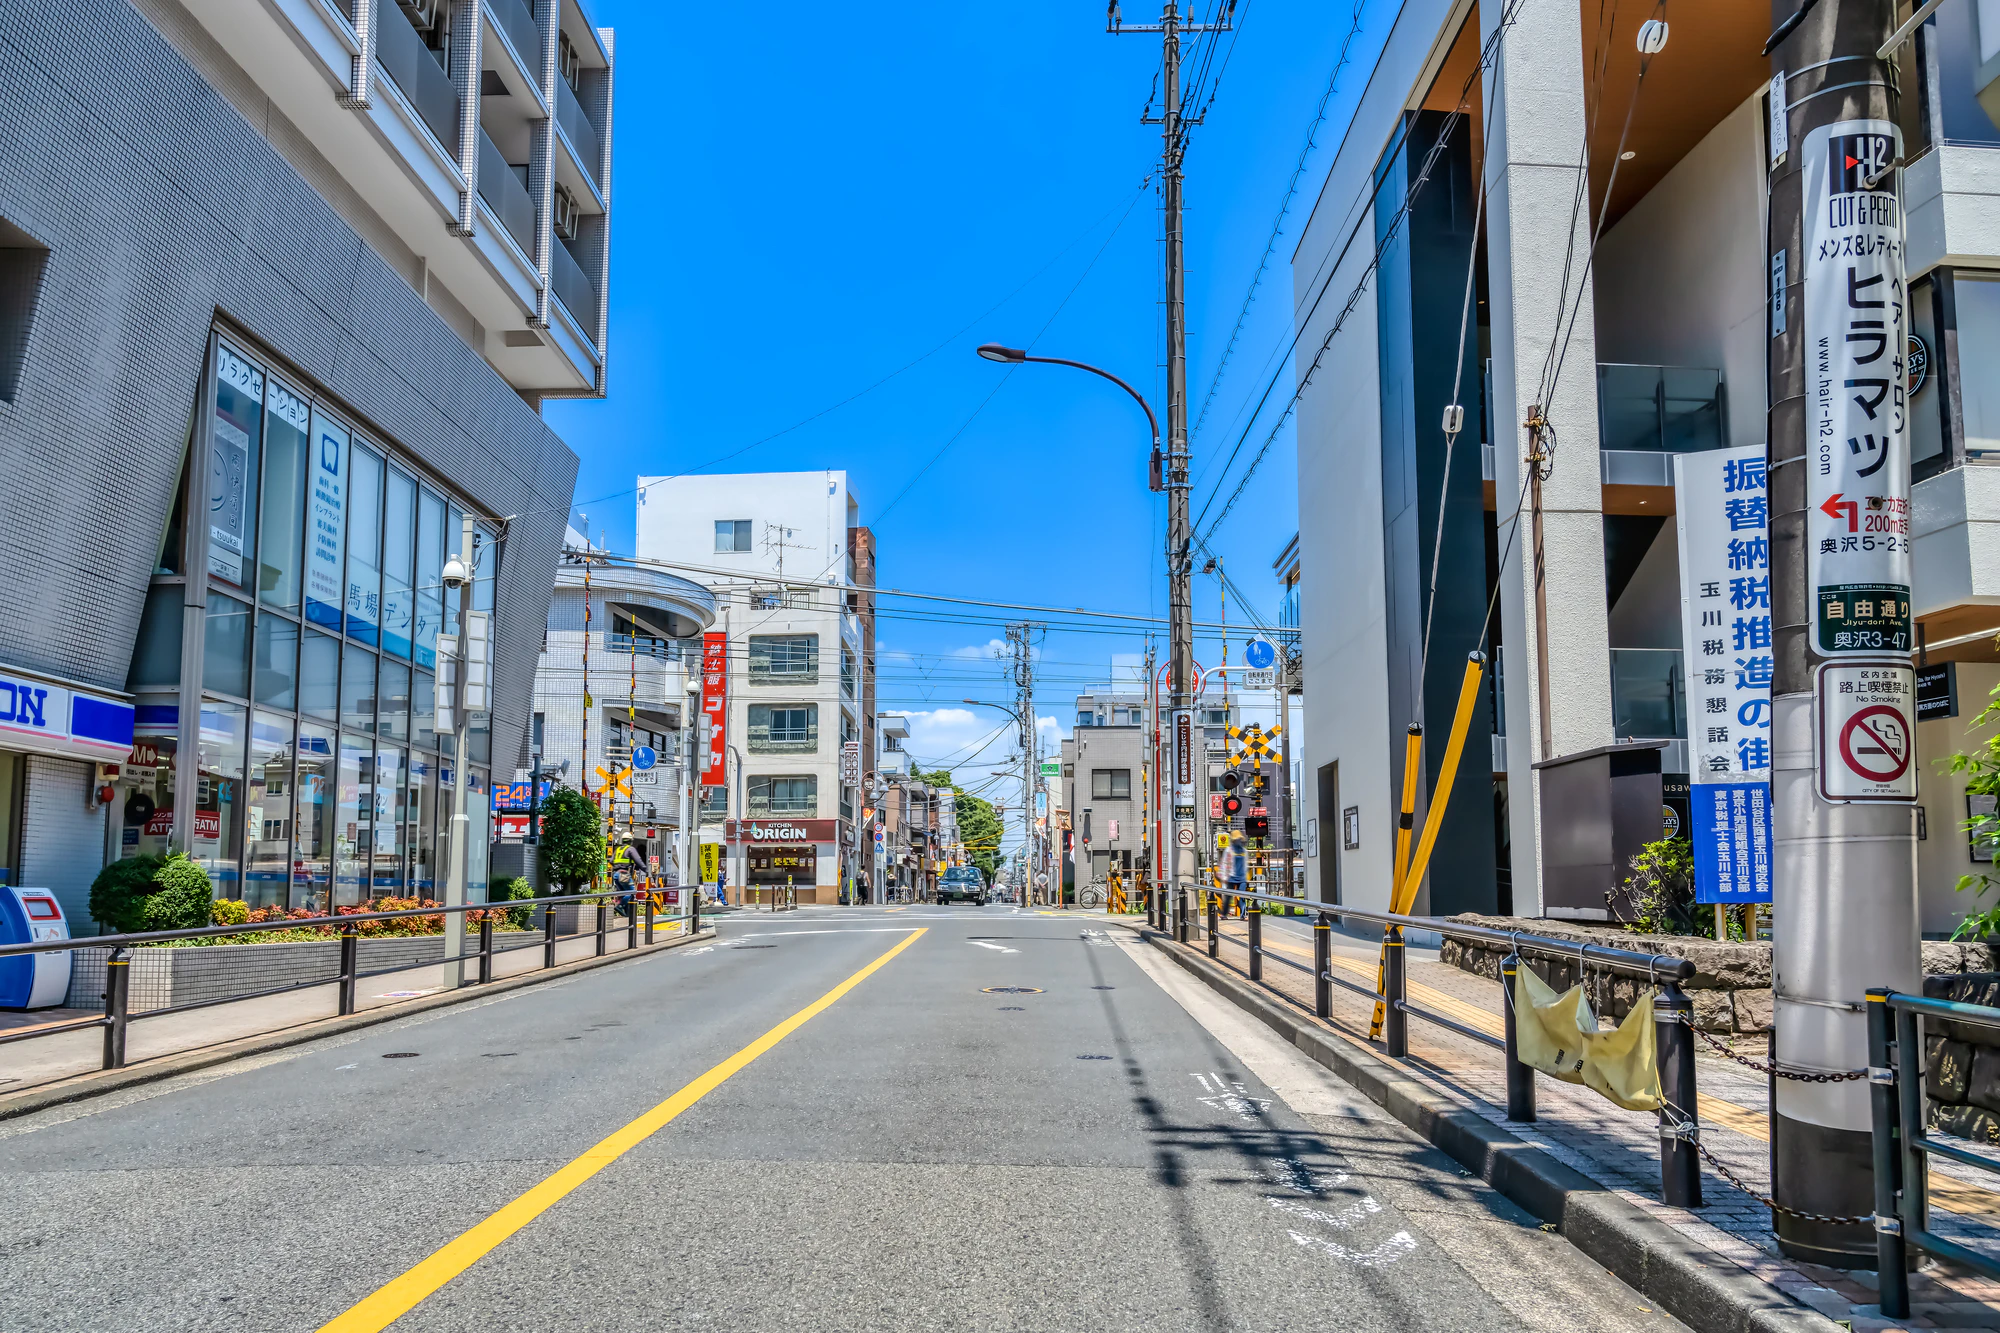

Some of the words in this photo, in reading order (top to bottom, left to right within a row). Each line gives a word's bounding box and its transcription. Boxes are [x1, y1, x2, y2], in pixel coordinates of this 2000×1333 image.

[1829, 195, 1855, 228] CUT
[1870, 195, 1897, 228] PERM
[1891, 277, 1905, 434] ヘアーサロン
[1844, 267, 1890, 478] ヒラマツ
[1819, 336, 1834, 476] www.hair-h2.com
[315, 503, 341, 524] インプラント
[1826, 599, 1909, 620] 自由通り
[1834, 631, 1907, 649] 奥沢3-47
[1699, 581, 1730, 772] 玉川税務懇話会
[1839, 680, 1909, 694] 路上喫煙禁止
[1856, 695, 1869, 703] No
[1871, 695, 1901, 704] Smoking
[753, 827, 807, 840] ORIGIN
